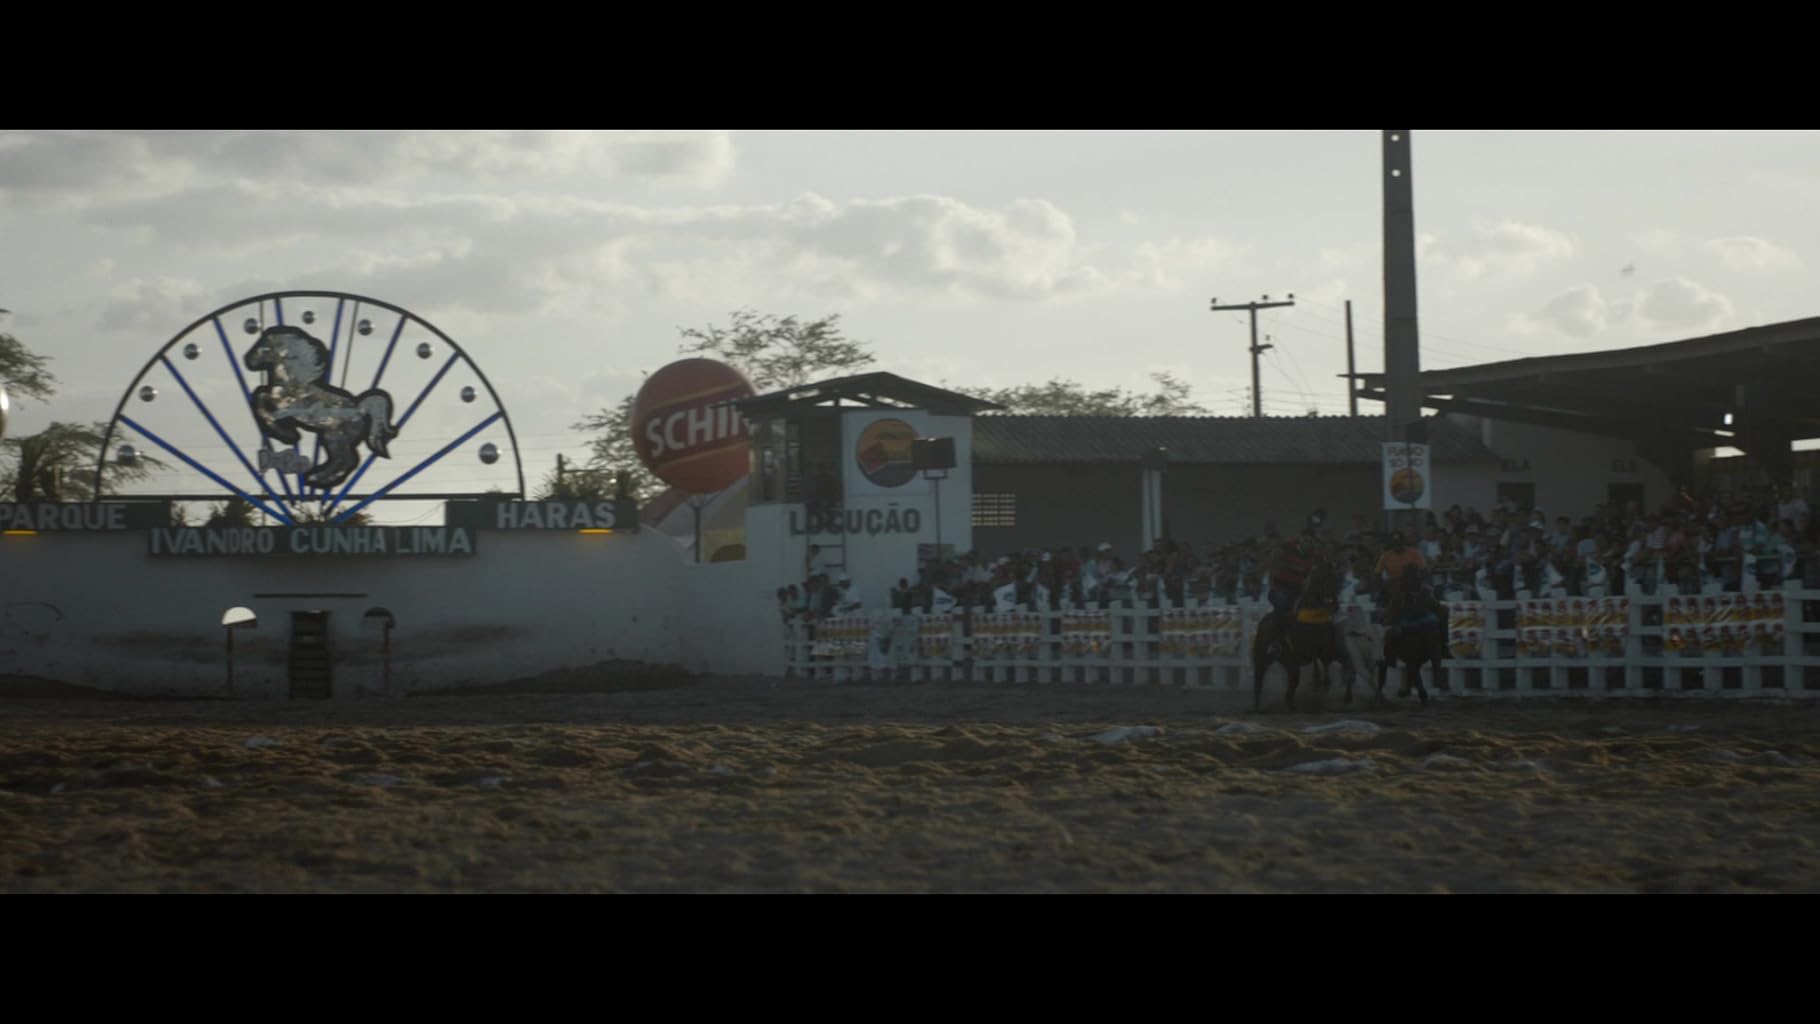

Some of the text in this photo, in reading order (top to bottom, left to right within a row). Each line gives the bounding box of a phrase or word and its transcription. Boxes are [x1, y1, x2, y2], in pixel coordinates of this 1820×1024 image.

[0, 502, 127, 530] PARQUE
[496, 501, 617, 529] HARAS
[789, 502, 921, 537] LOCUÇÃO
[151, 527, 472, 555] IVANDRO CUNHA LIMA
